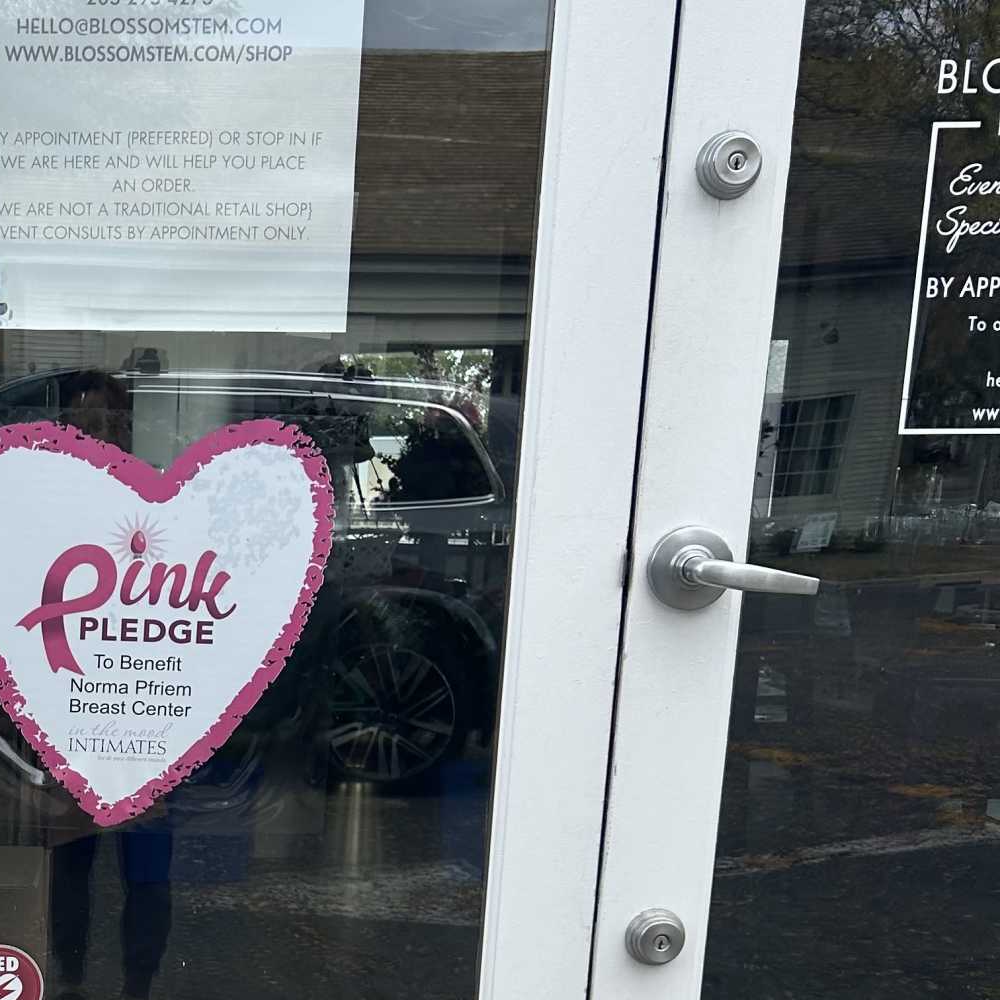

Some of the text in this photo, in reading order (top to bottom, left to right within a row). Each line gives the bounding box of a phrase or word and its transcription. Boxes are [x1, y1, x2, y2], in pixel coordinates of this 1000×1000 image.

[16, 17, 282, 35] HELLO@BLOSSOMSTEM.COM
[5, 45, 293, 63] WWW.BLOSSOMSTEM.COM/SHOP
[14, 131, 122, 146] APPOINTMENT
[127, 131, 213, 149] (PREFERRED)
[218, 131, 241, 146] OR
[246, 131, 285, 146] STOP
[289, 131, 306, 146] IN
[311, 131, 323, 146] IF
[0, 155, 306, 170] WE ARE HERE AND WILL HELP YOU PLACE
[112, 178, 196, 193] AN ORDER.
[26, 202, 55, 216] ARE
[59, 202, 93, 216] NOT
[98, 202, 109, 216] A
[113, 202, 211, 217] TRADITIONAL
[216, 202, 261, 217] RETAIL
[42, 225, 122, 240] CONSULTS
[127, 226, 146, 240] BY
[150, 225, 260, 241] APPOINTMENT
[263, 225, 310, 241] ONLY.
[926, 276, 955, 299] BY
[967, 315, 987, 331] To
[14, 541, 237, 676] Pink
[79, 617, 214, 645] PLEDGE
[94, 654, 182, 672] To Benefit
[70, 678, 192, 697] Norma Pfriem
[69, 699, 192, 718] Breast Center
[92, 720, 119, 737] the
[68, 737, 168, 756] INTIMATES
